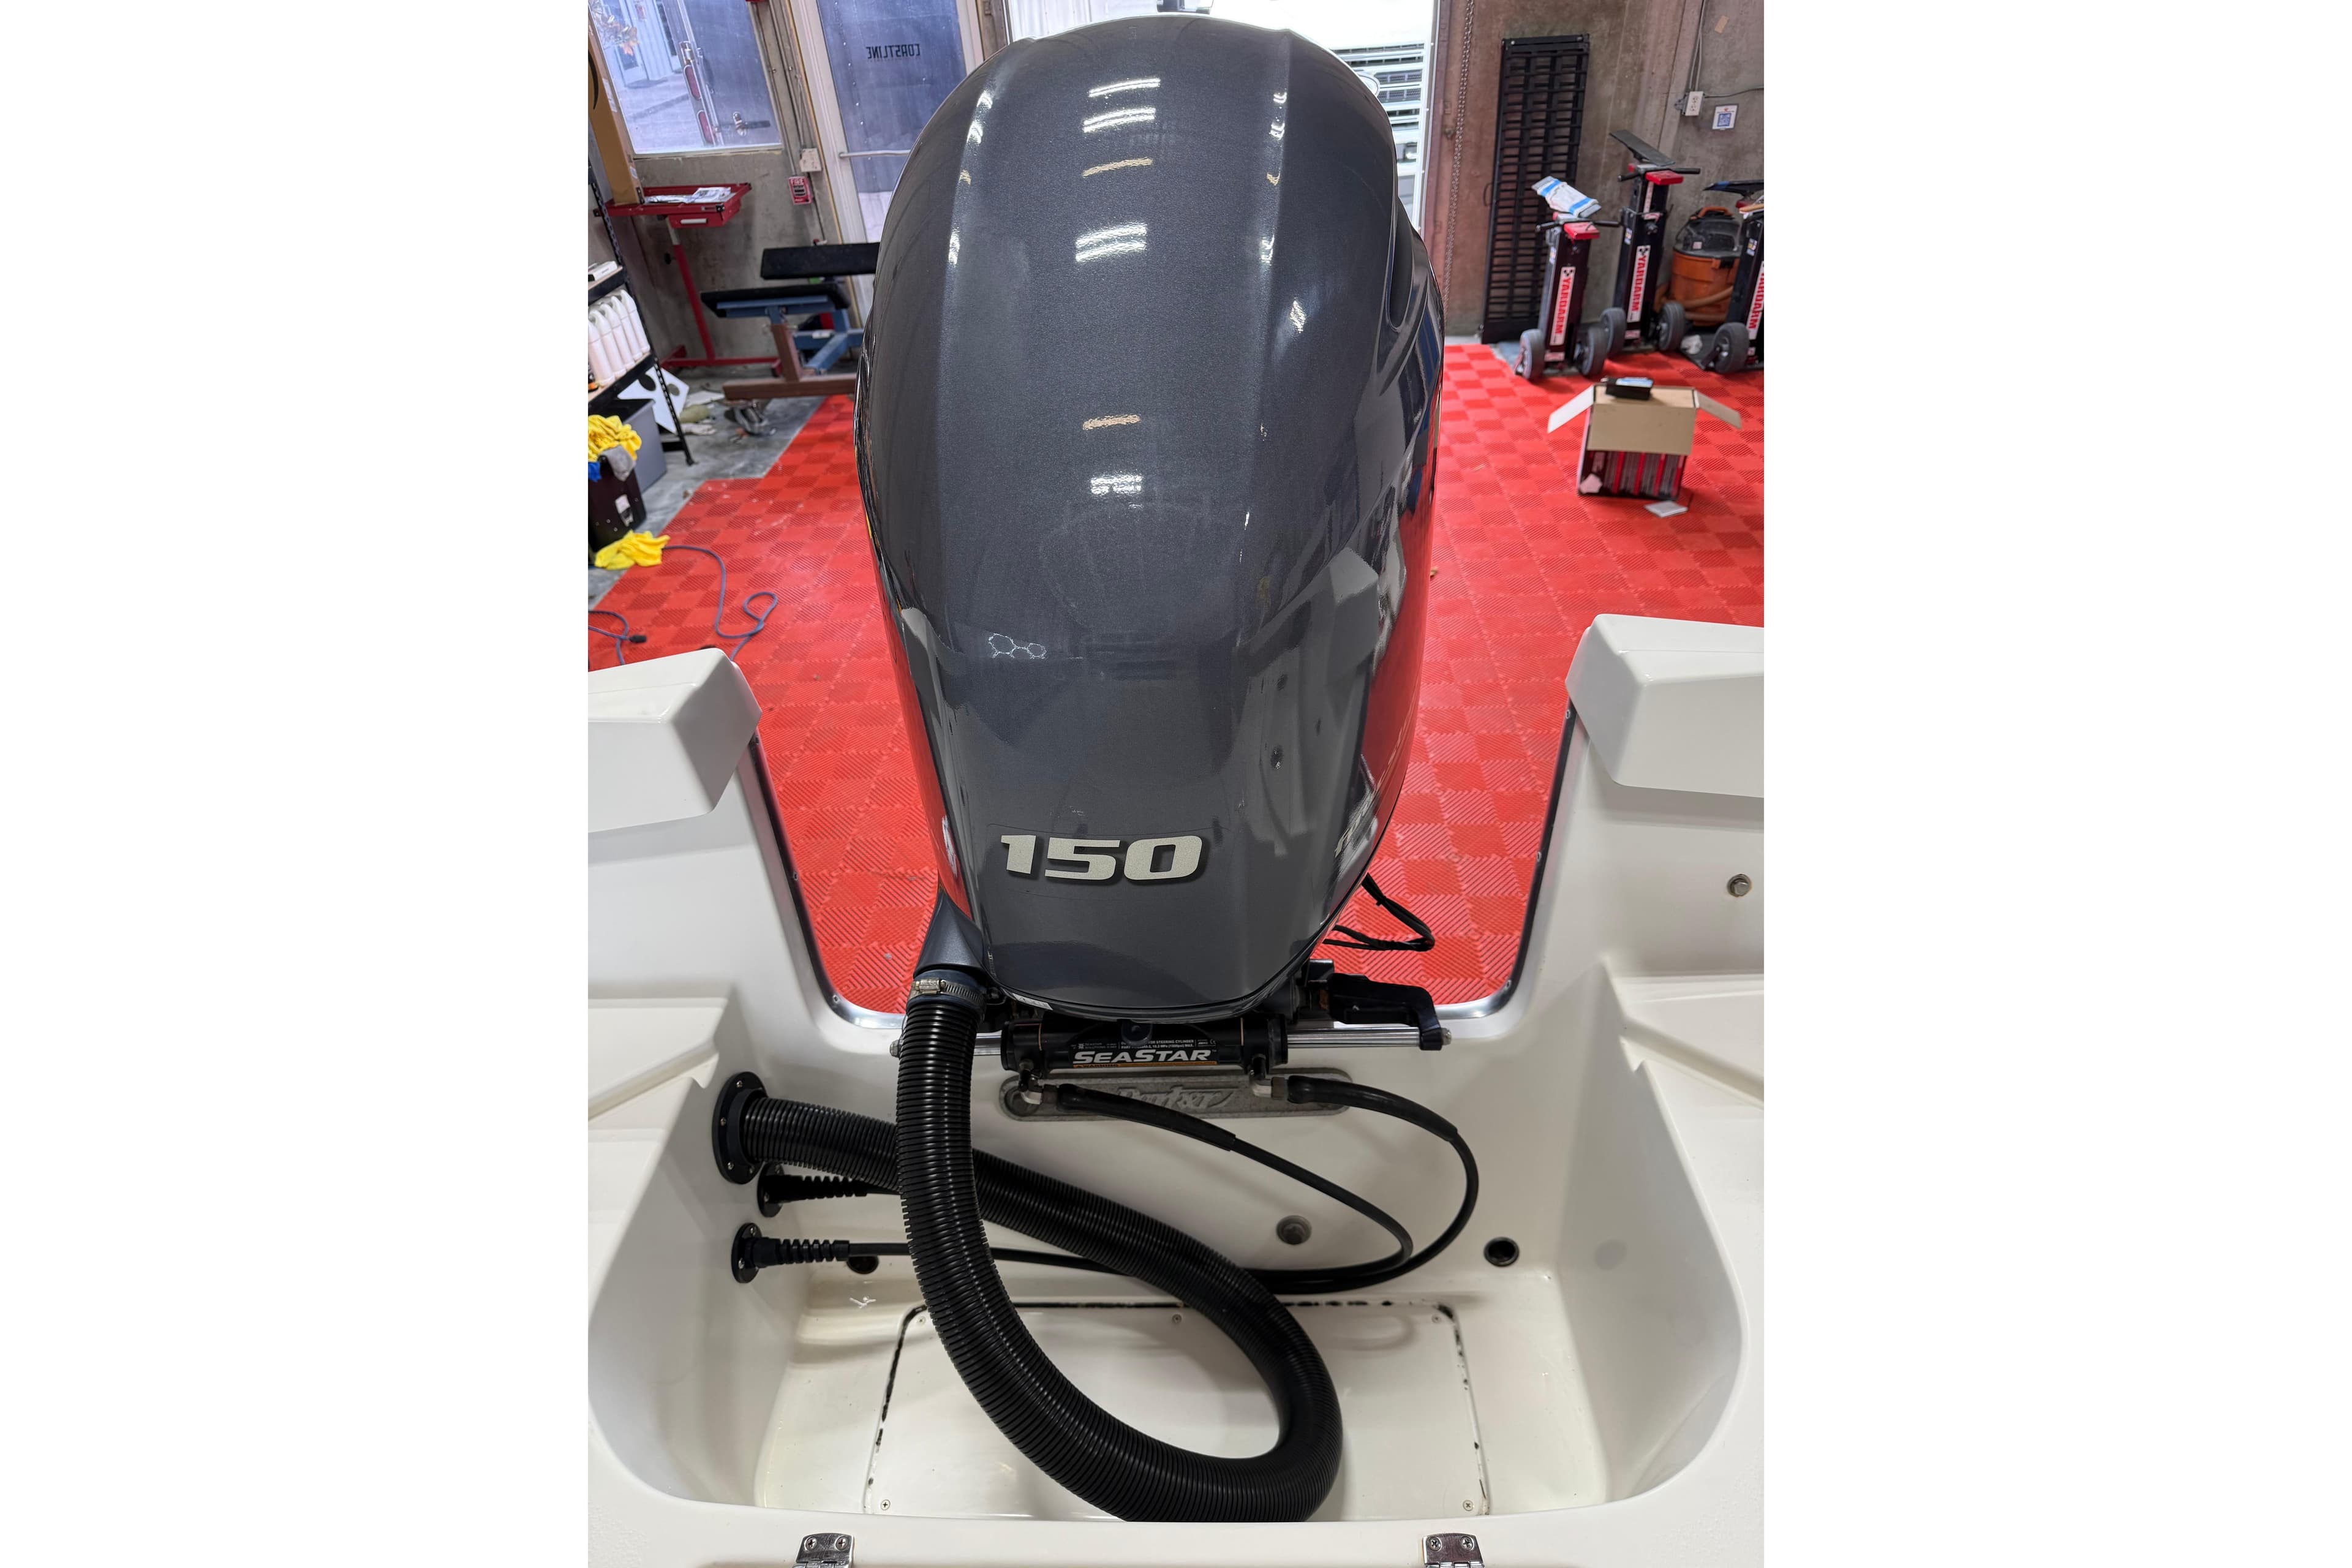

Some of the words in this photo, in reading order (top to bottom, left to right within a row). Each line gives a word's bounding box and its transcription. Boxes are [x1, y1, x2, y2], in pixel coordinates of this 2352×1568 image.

[1555, 277, 1571, 334] YARDARM
[1632, 255, 1647, 312] YARDARM
[1000, 834, 1203, 881] 150
